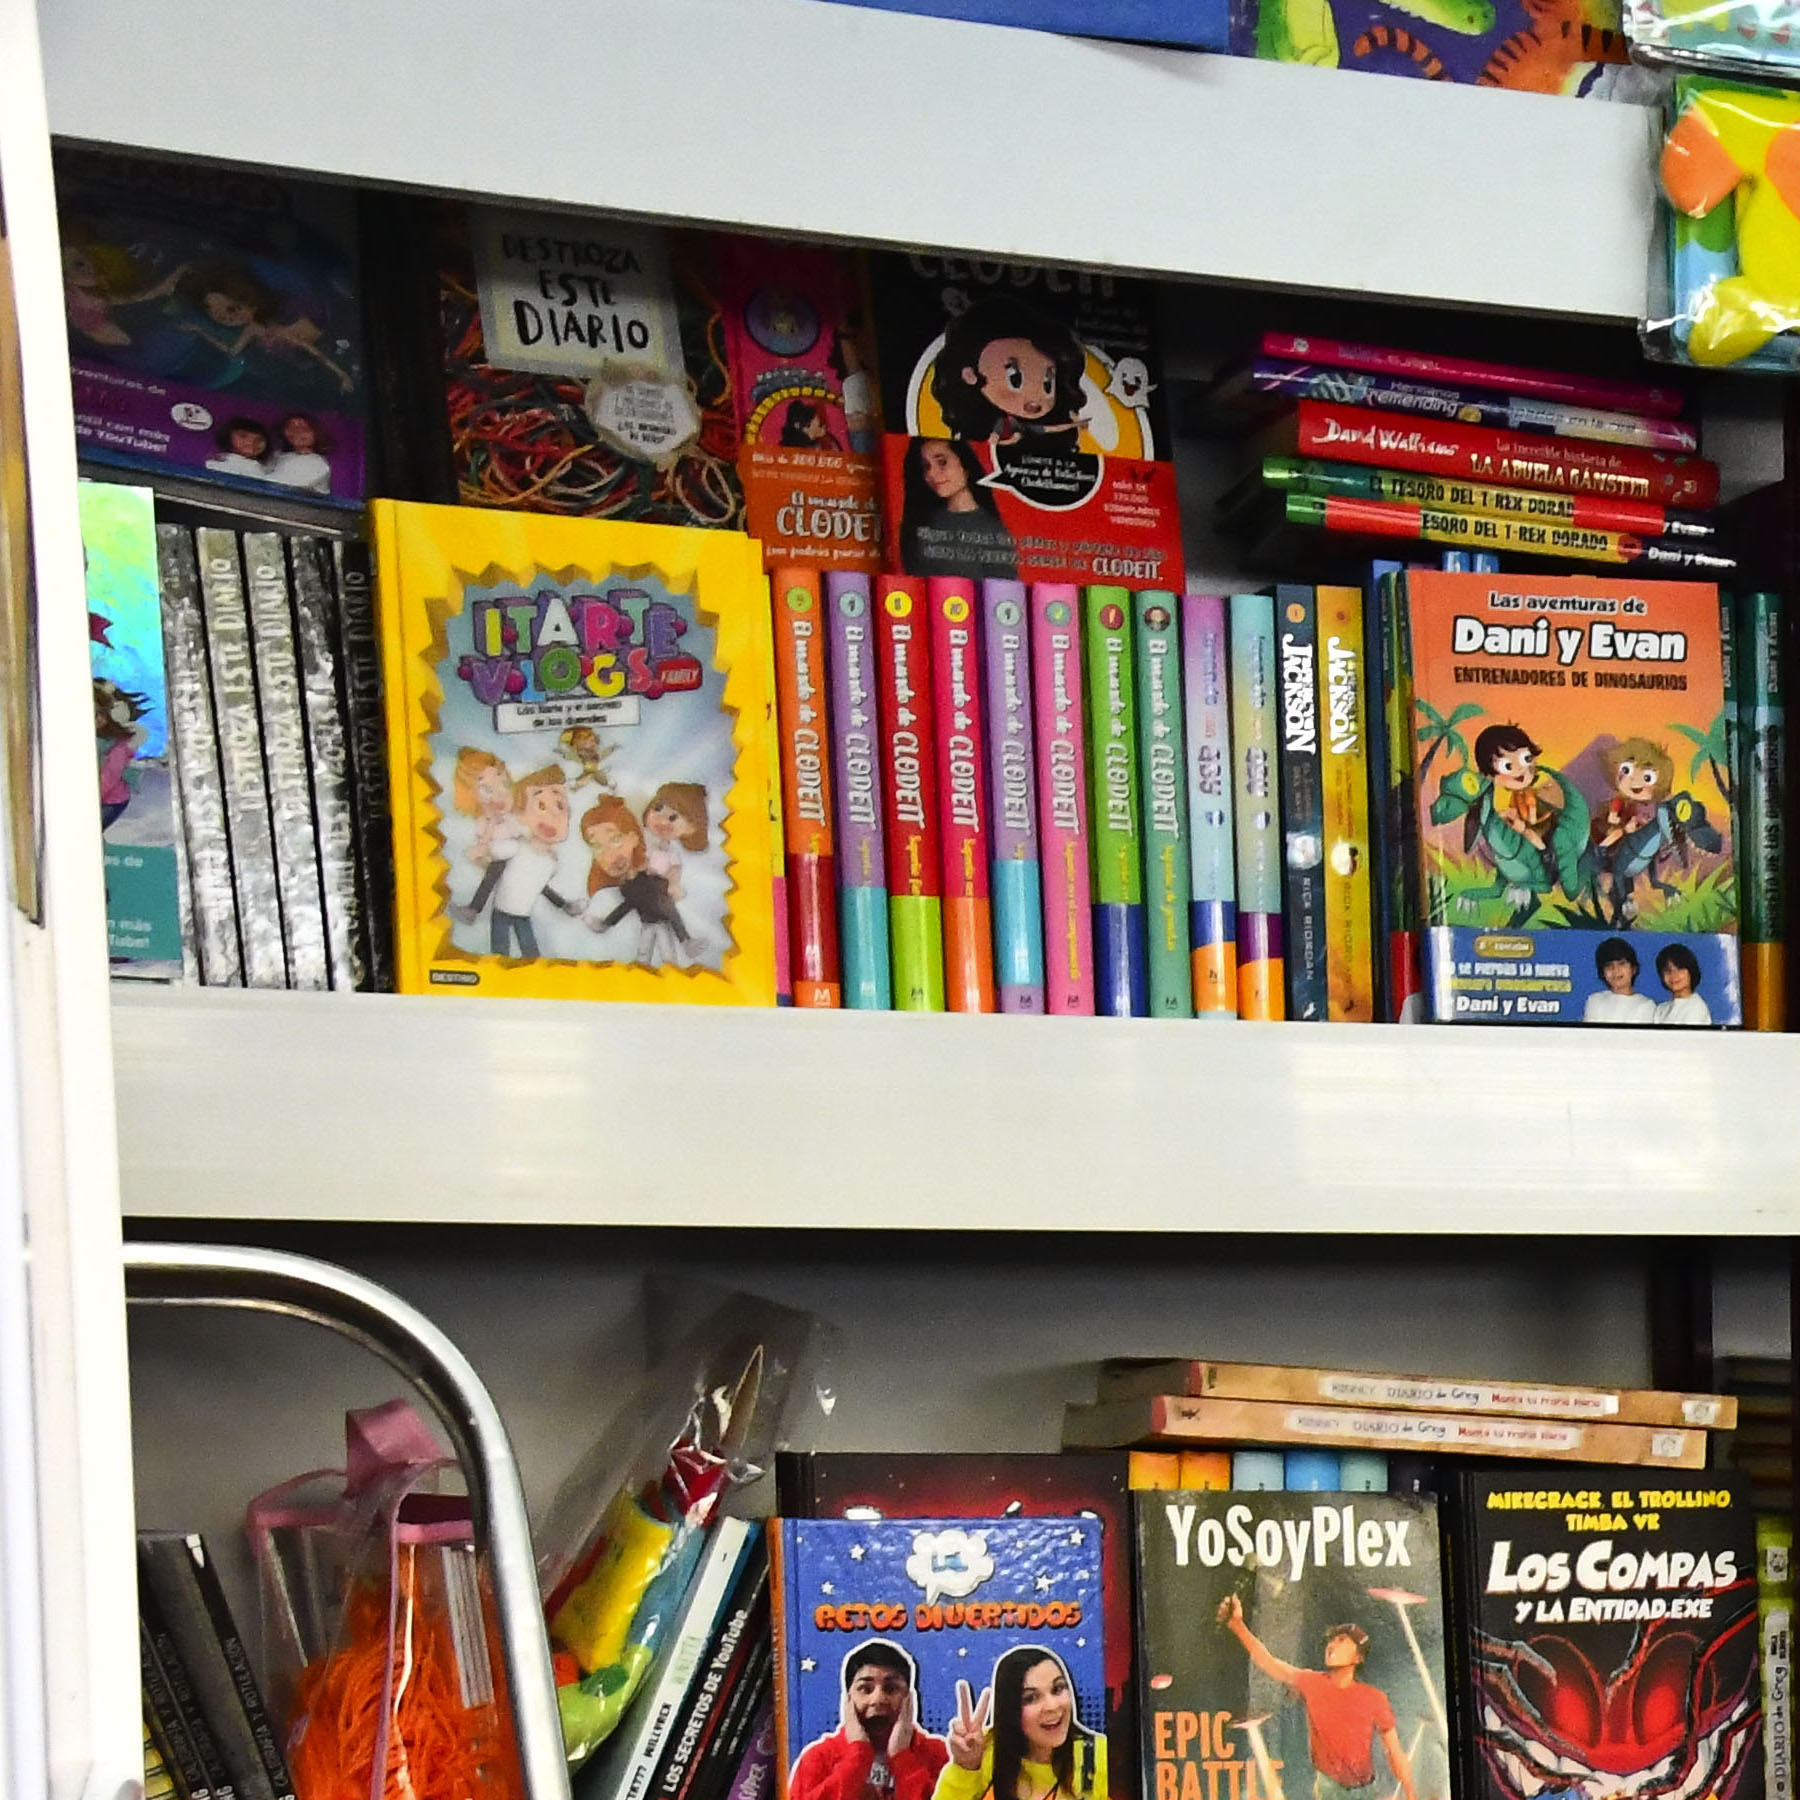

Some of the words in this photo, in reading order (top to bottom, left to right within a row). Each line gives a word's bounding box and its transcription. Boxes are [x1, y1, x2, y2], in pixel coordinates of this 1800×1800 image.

[540, 269, 616, 307] ESTE
[514, 300, 649, 353] DIARIO
[1313, 419, 1373, 451] David
[1380, 429, 1459, 457] Walliams
[1391, 479, 1445, 502] TESORO
[1450, 487, 1476, 505] DEL
[1471, 454, 1493, 473] LA
[1500, 459, 1565, 487] ABUELA
[1570, 464, 1649, 497] GÁNSTER
[1473, 520, 1498, 538] DEL
[1551, 529, 1609, 551] DORADO
[1490, 590, 1521, 610] Las
[1526, 594, 1617, 615] aventuras
[1622, 598, 1646, 615] de
[473, 588, 686, 658] ITARTE
[1453, 617, 1549, 656] Dani
[1557, 629, 1583, 664] y
[1590, 621, 1687, 661] Evan
[458, 648, 664, 702] VLOGS
[1454, 666, 1566, 688] ENTRENADORES
[1571, 671, 1590, 688] DE
[1594, 671, 1687, 691] DINOSAURIOS
[1282, 634, 1315, 755] JACKSON
[1326, 636, 1358, 755] JACKSON
[1456, 997, 1498, 1012] Dani
[1503, 1000, 1514, 1015] y
[1517, 997, 1560, 1013] Evan
[1450, 1386, 1480, 1405] Greg
[1415, 1420, 1446, 1439] Greg
[1611, 1491, 1634, 1508] EL
[1567, 1513, 1627, 1531] TIMBA
[1633, 1513, 1660, 1531] VK
[1167, 1503, 1411, 1580] YoSoyPlex
[1486, 1541, 1570, 1594] LOS
[1576, 1540, 1738, 1592] COMPAS
[814, 1603, 908, 1630] RETOS
[915, 1601, 1081, 1630] DIVERTIDOS
[1516, 1603, 1530, 1622] Y
[1536, 1603, 1563, 1622] LA
[1569, 1597, 1713, 1622] ENTIDAD.EXE
[709, 1608, 748, 1674] YouTube
[700, 1672, 720, 1704] DE
[1771, 1667, 1787, 1704] Greg
[670, 1698, 709, 1763] SECRETOS
[1155, 1711, 1234, 1760] EPIC
[662, 1760, 685, 1794] LOS
